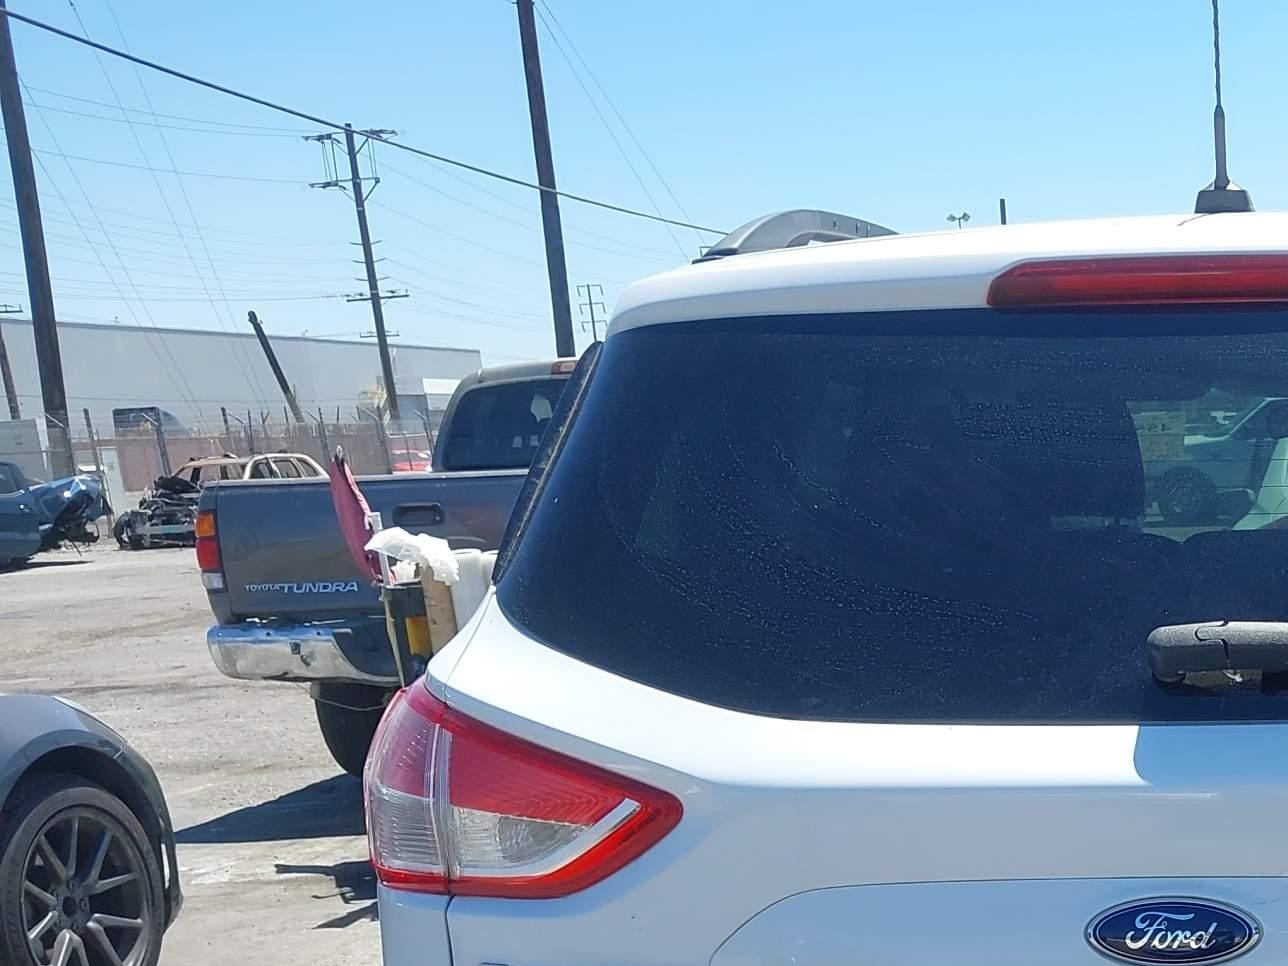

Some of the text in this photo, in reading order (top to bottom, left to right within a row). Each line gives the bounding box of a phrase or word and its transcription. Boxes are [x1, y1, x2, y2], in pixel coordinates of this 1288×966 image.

[244, 581, 359, 594] TOYOTA TUNDRA
[1125, 911, 1218, 949] Ford
